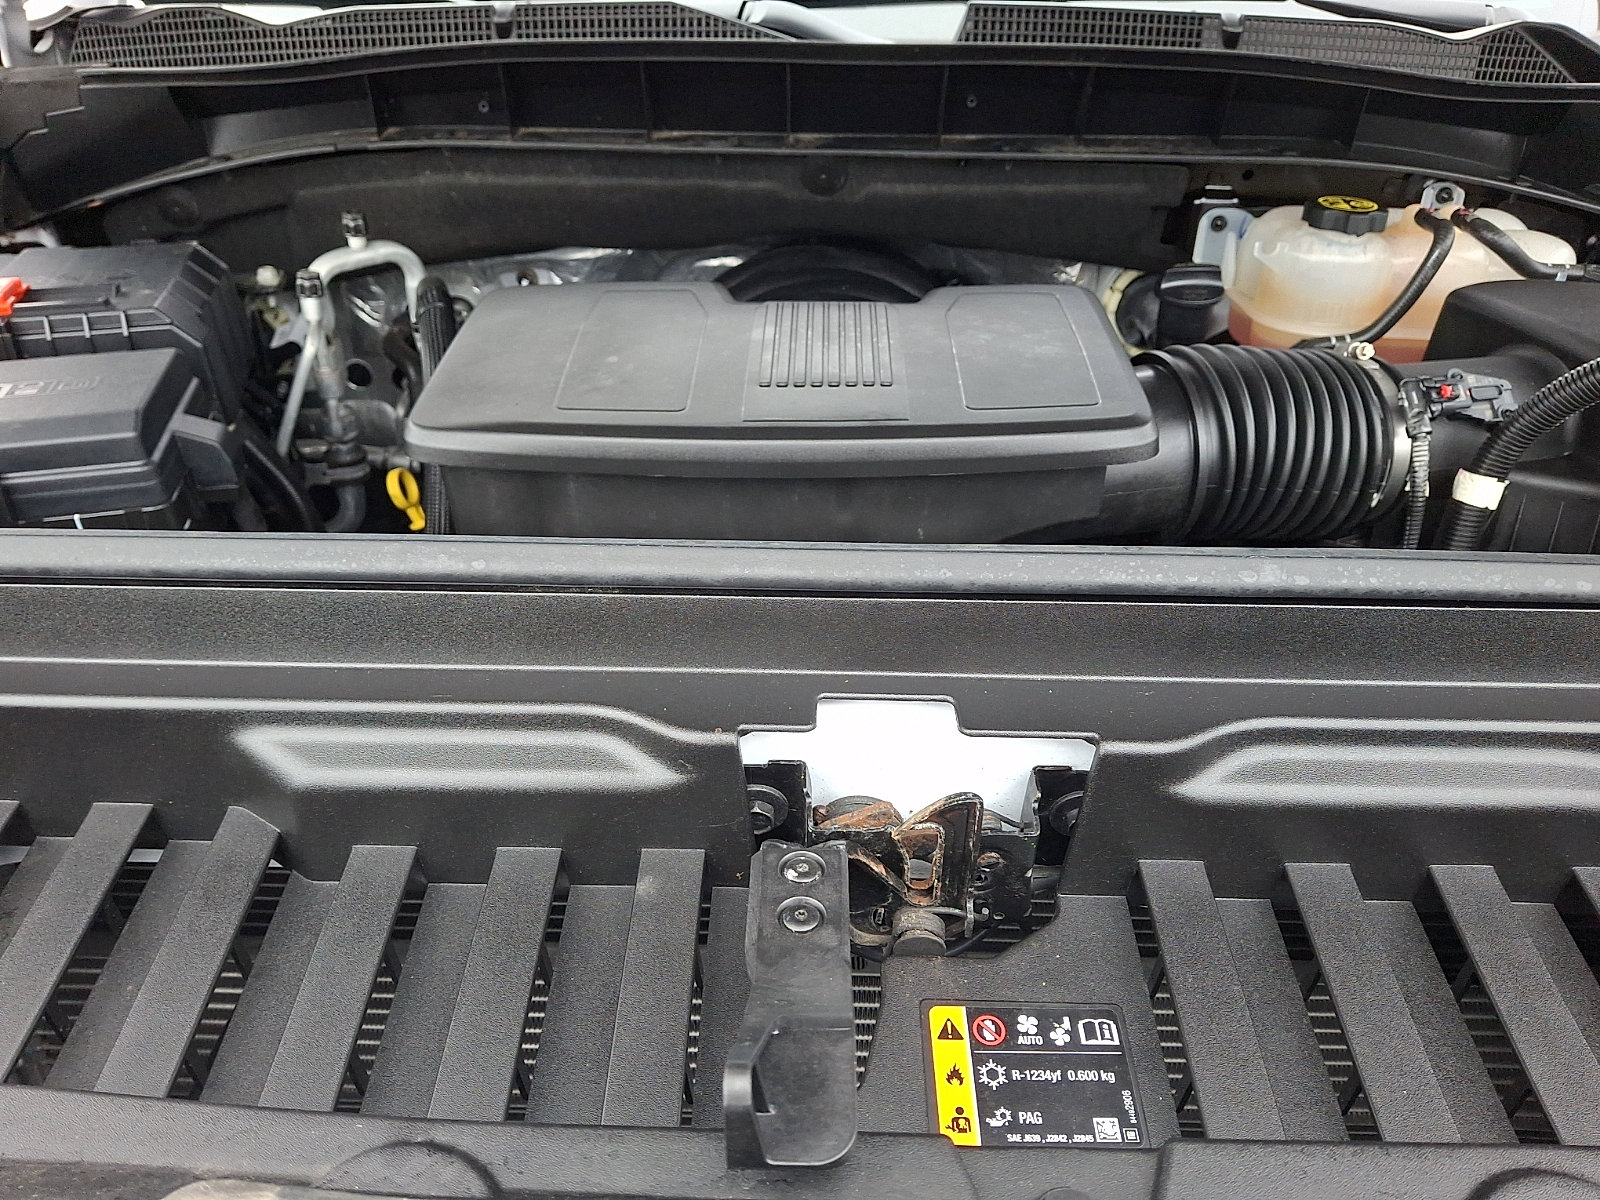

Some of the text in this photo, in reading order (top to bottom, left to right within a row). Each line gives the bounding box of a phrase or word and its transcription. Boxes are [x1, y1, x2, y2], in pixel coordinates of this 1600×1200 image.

[1017, 1035, 1044, 1046] AUTO
[1011, 1069, 1116, 1084] R-1234yf 0.600 kg
[1018, 1111, 1043, 1125] PAG
[1006, 1133, 1022, 1143] SAE
